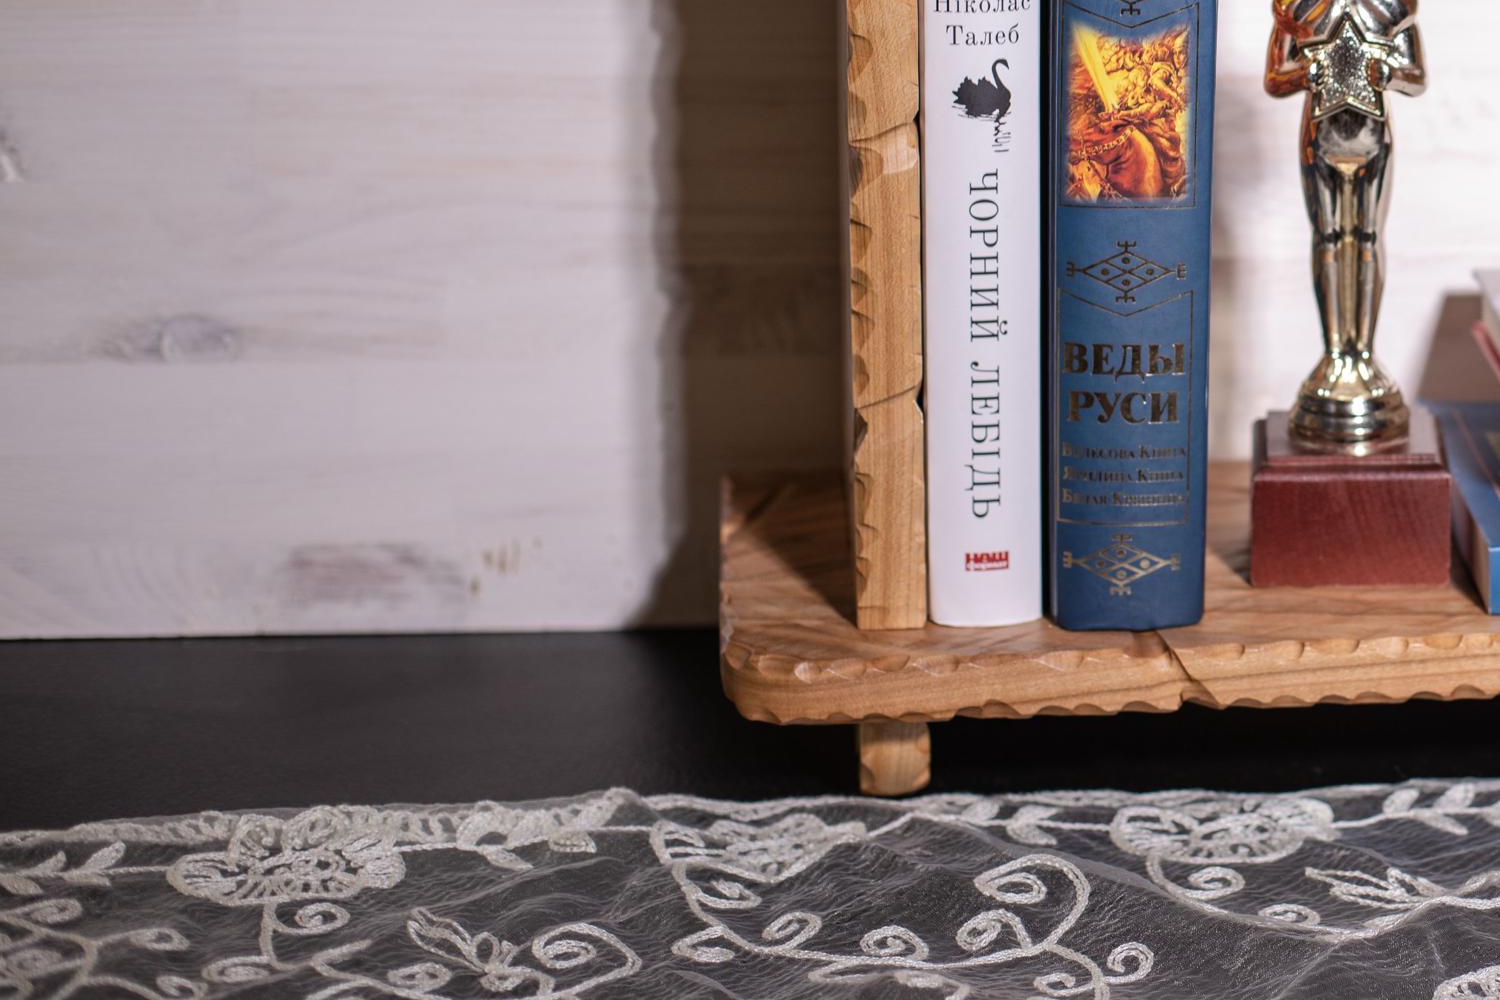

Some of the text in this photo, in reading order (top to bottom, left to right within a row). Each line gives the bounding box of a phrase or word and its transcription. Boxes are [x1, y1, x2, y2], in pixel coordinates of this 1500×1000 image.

[945, 23, 1020, 46] Талеб
[968, 167, 1009, 342] ЧОРНИЙ
[1062, 342, 1186, 383] ВЕДЫ
[1067, 391, 1179, 424] РУСИ
[964, 361, 1001, 520] ЛЕБІДЬ
